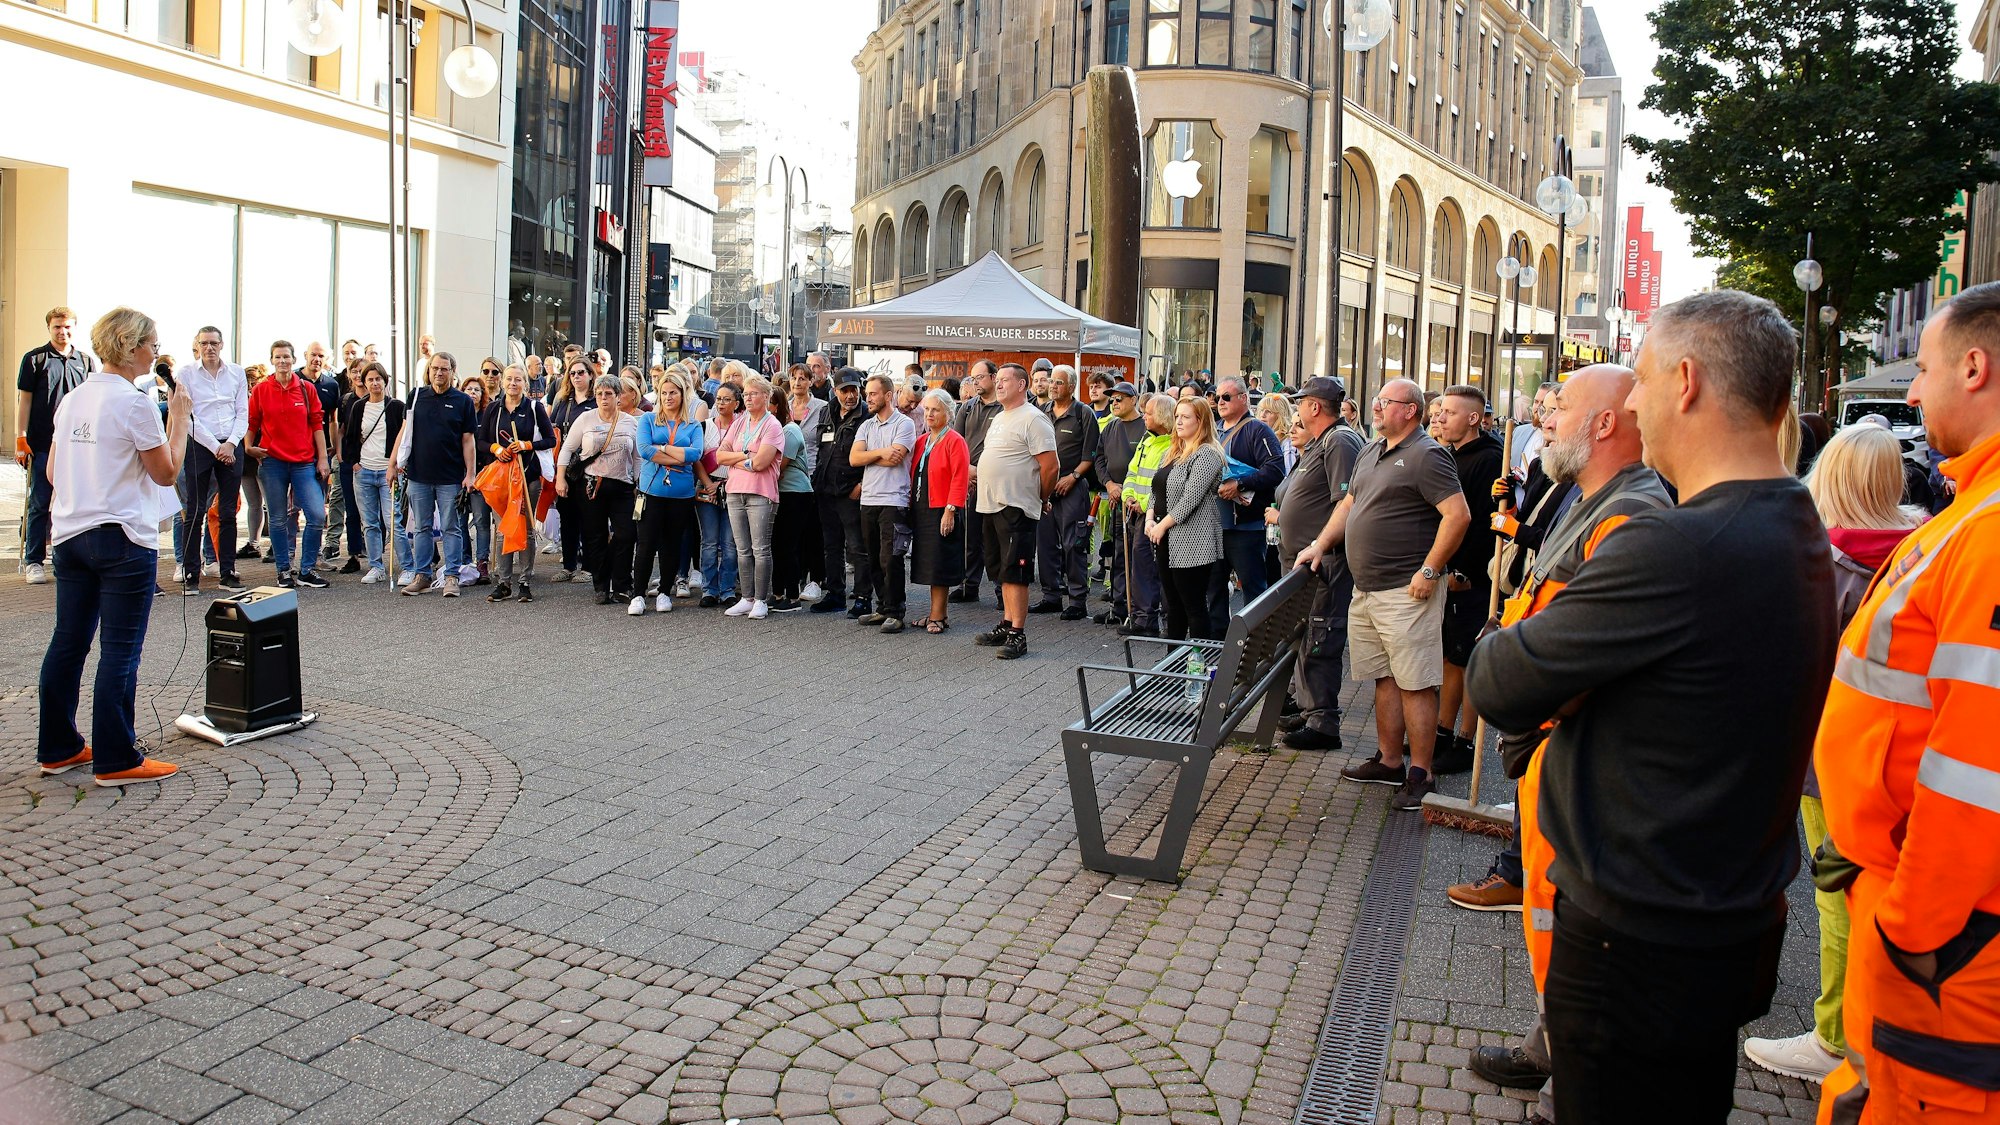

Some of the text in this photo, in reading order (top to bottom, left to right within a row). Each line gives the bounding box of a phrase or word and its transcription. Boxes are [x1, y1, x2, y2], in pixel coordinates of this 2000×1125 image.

[1627, 239, 1639, 278] UNIQLO
[1640, 260, 1652, 295] UNIQLO
[1650, 276, 1660, 307] UNIQLO
[844, 319, 875, 335] AWB
[926, 325, 1071, 341] EINFACH. SAUBER. BESSER.
[940, 364, 964, 378] AWB
